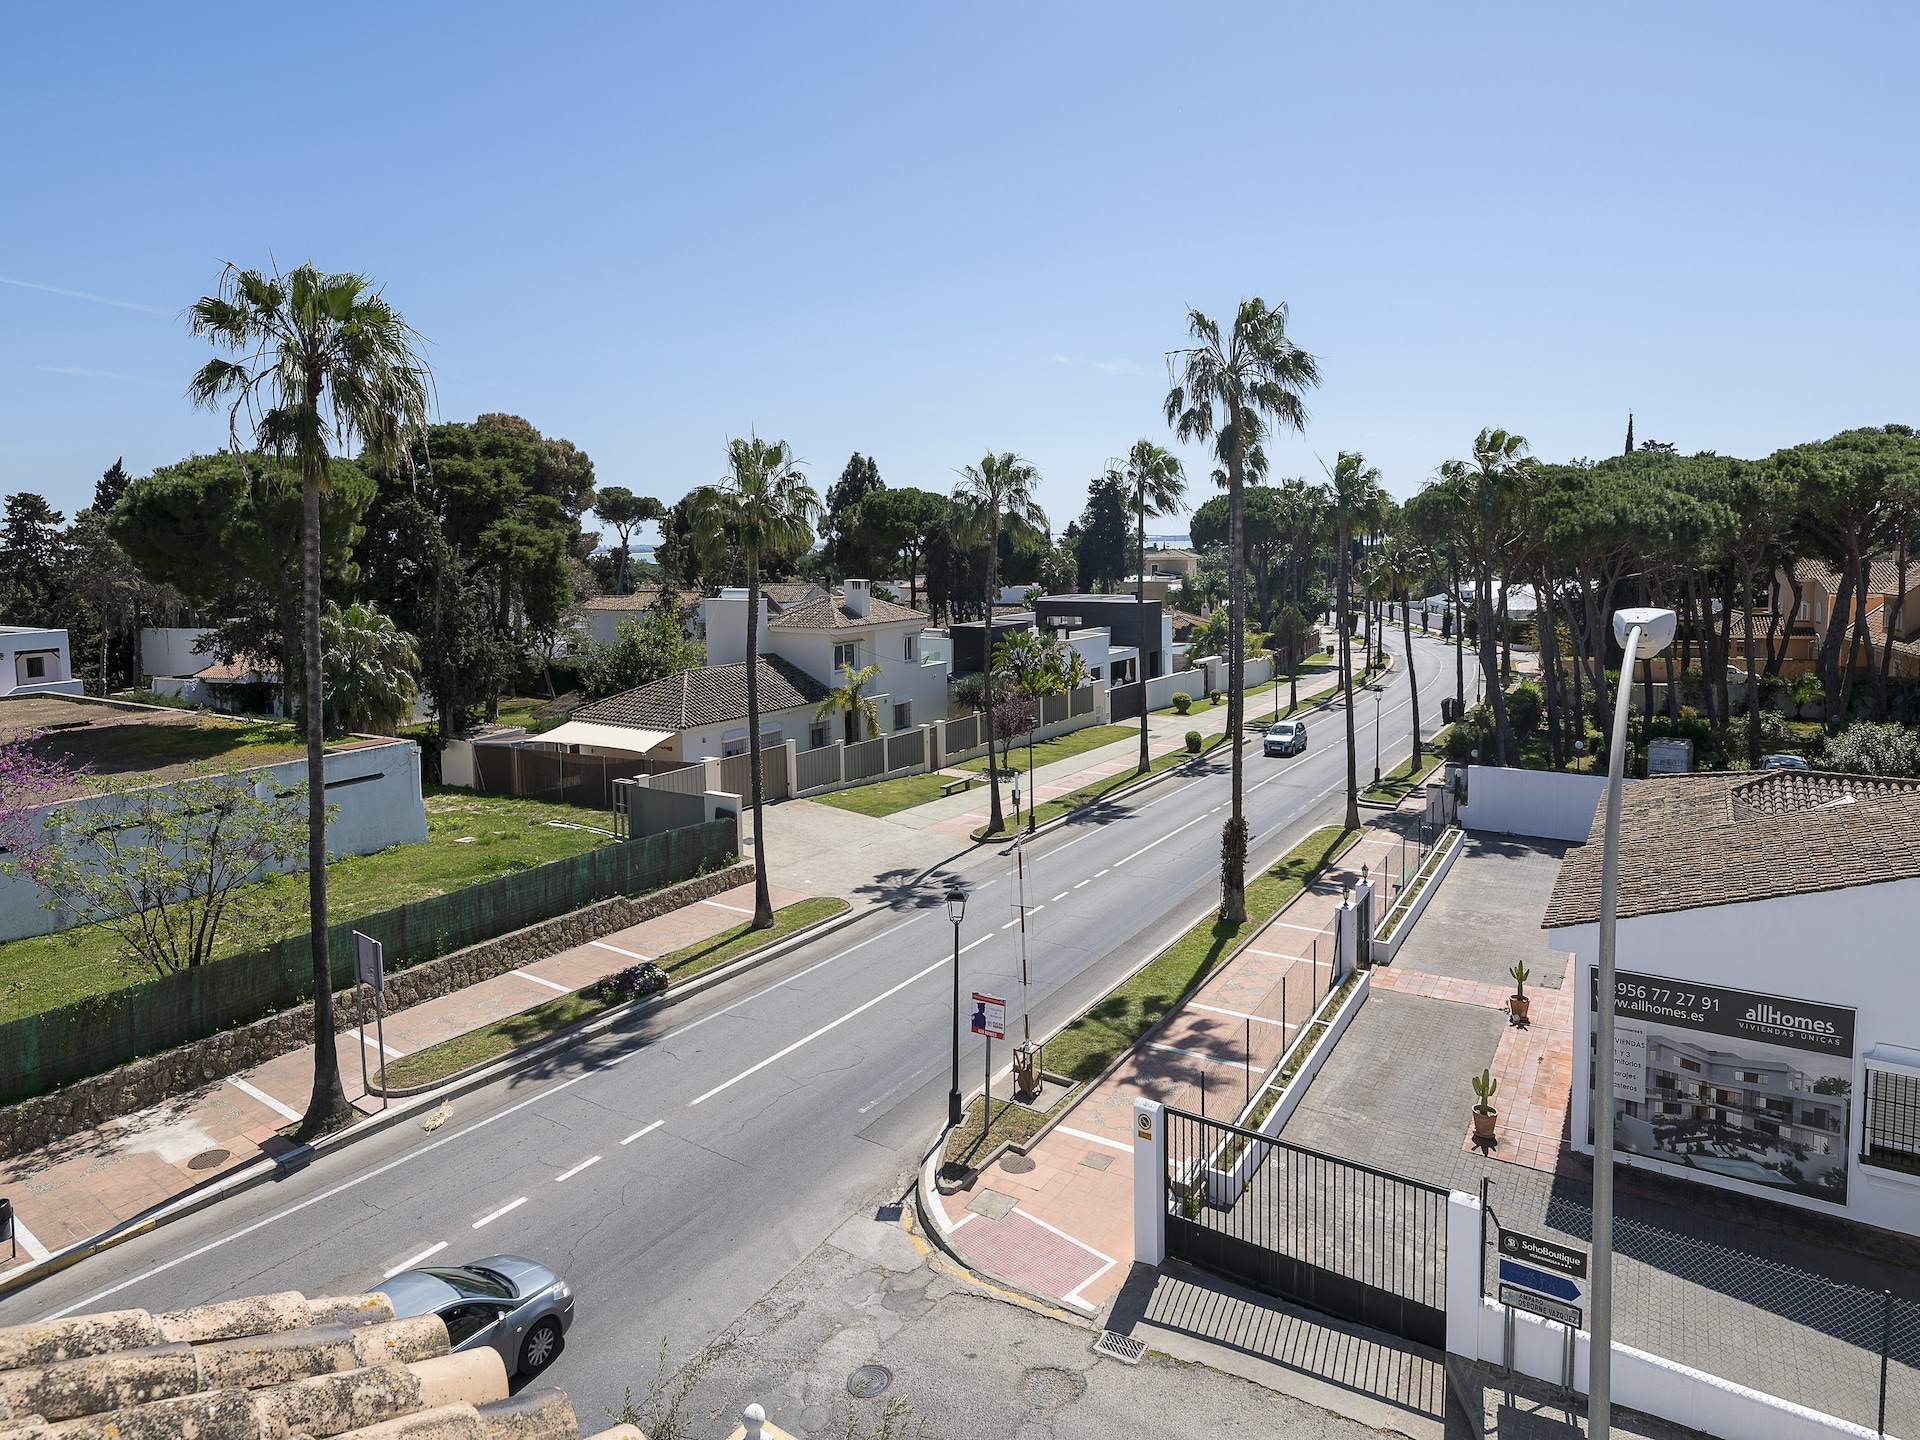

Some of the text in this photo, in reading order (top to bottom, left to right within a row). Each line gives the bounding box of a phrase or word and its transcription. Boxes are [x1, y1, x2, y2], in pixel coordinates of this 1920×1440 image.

[1651, 987, 1671, 1003] 77
[1675, 992, 1696, 1007] 27
[1701, 996, 1720, 1012] 91
[1745, 1003, 1835, 1034] allHomes
[1738, 1022, 1795, 1038] VIVIENDAS
[1614, 1037, 1646, 1049] VIENDAS
[1614, 1058, 1642, 1069] mitorios
[1613, 1070, 1637, 1080] arajes
[1521, 1240, 1581, 1266] SohoBoutique
[1517, 1299, 1547, 1315] OSBORNE
[1519, 1293, 1544, 1305] AMPARO
